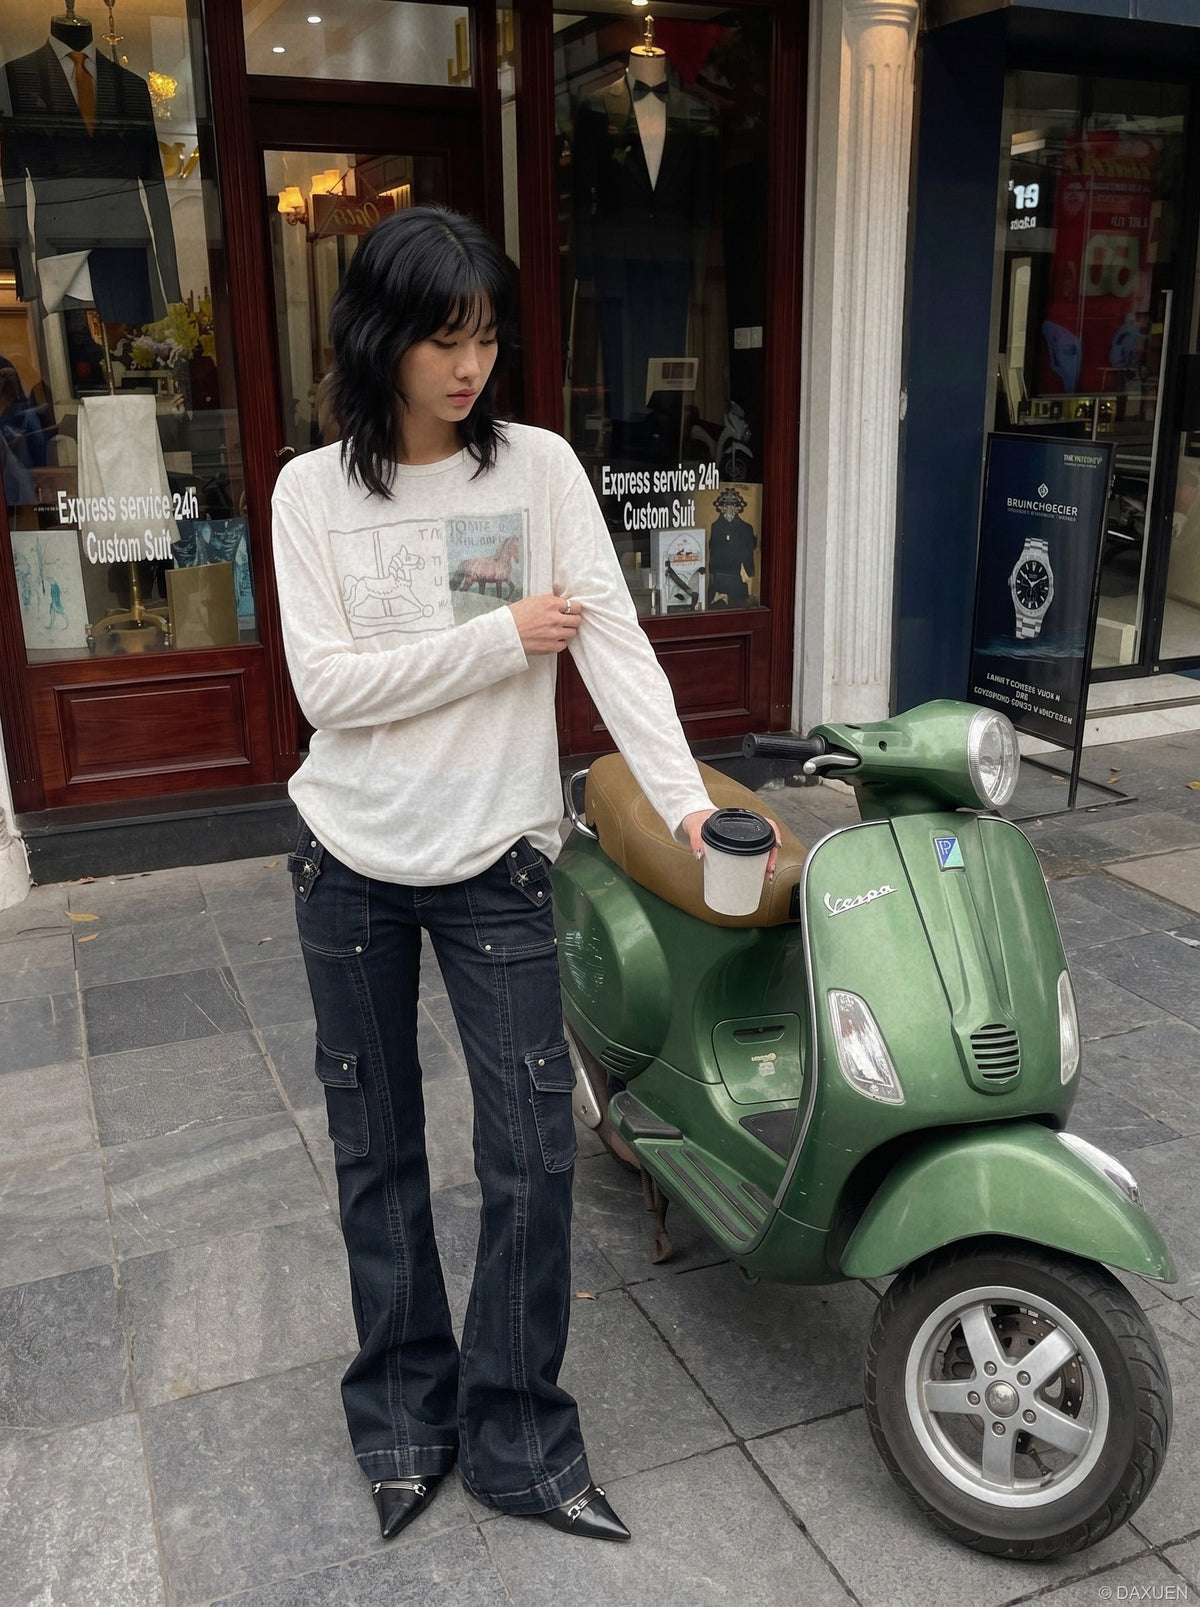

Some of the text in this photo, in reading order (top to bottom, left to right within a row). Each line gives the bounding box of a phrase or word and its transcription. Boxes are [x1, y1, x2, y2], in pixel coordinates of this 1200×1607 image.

[602, 462, 720, 502] Express service 24h
[57, 486, 199, 530] Express service 24h
[624, 499, 696, 531] Custom Suit
[86, 529, 174, 564] Custom Suit
[823, 884, 898, 918] Vespa
